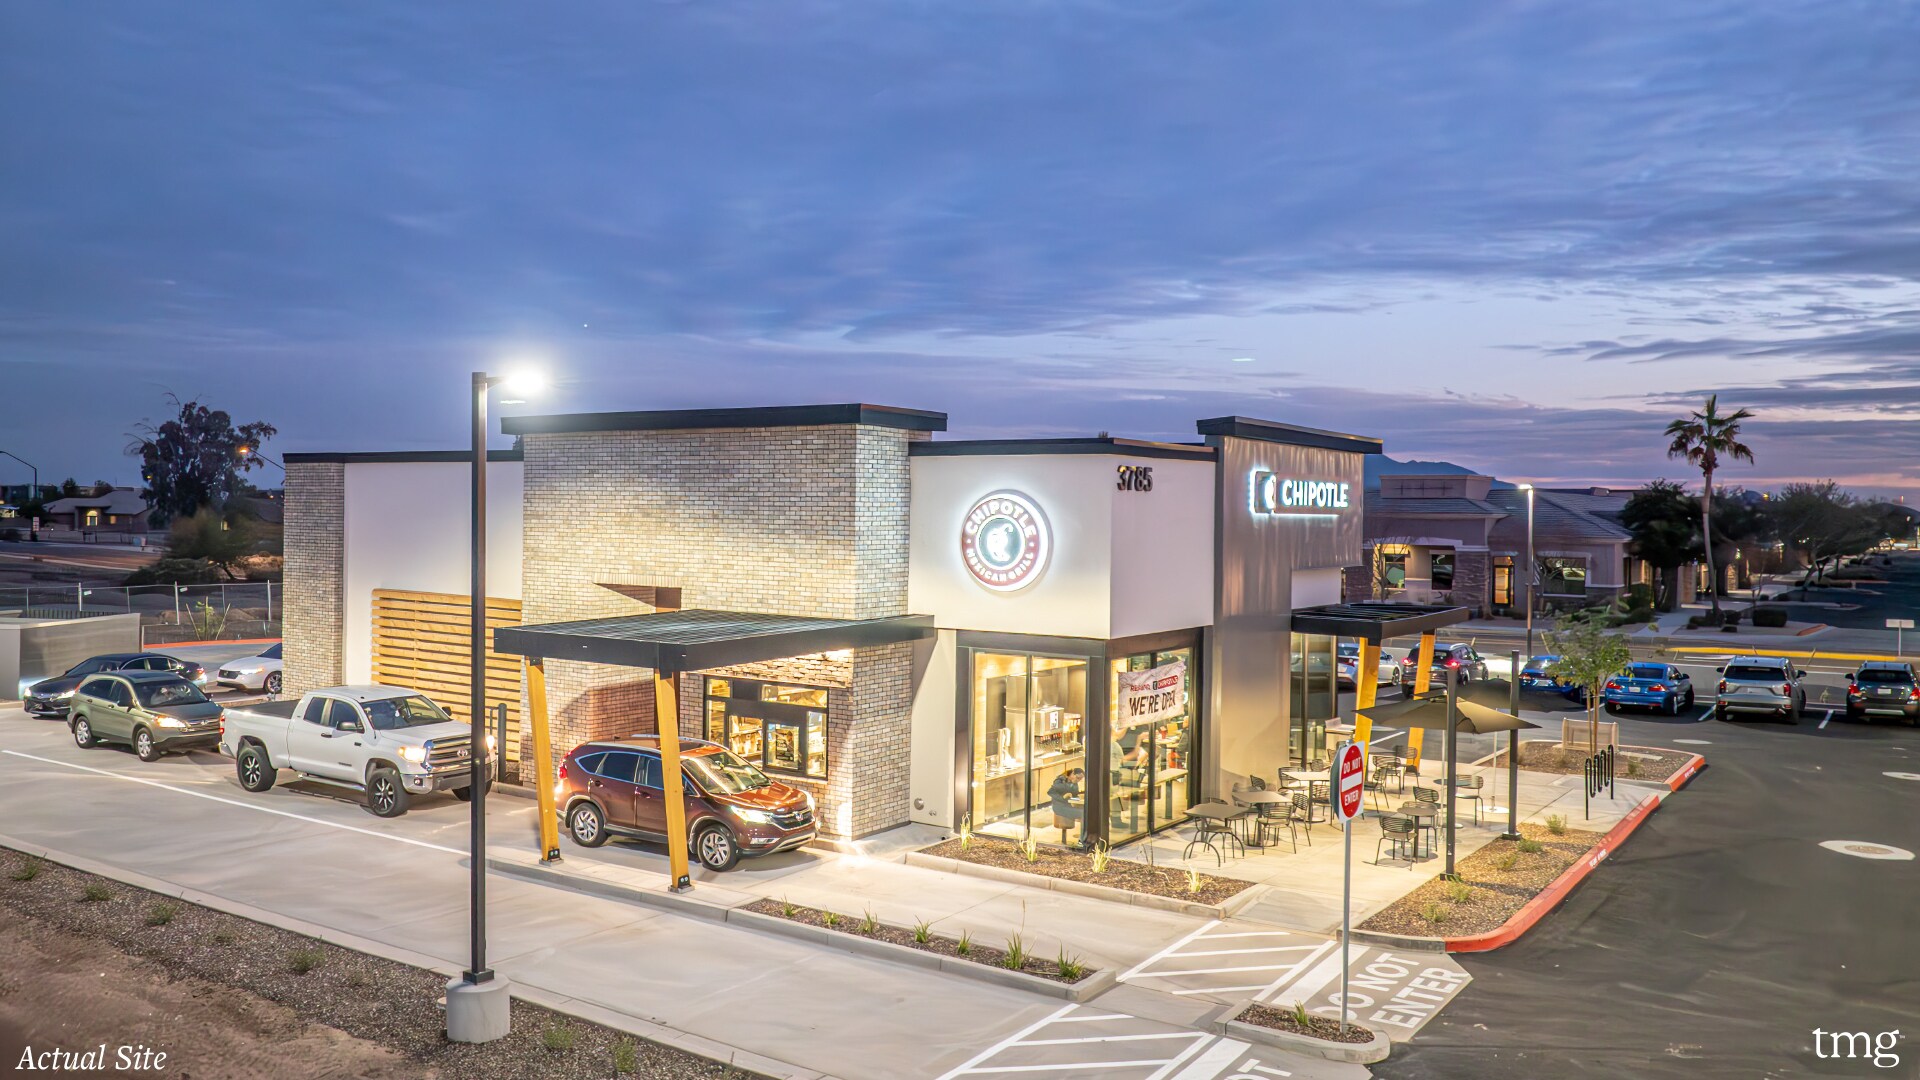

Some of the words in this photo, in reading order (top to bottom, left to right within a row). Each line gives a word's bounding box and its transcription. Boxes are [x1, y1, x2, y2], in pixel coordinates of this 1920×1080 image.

[1117, 465, 1153, 491] 3785
[1282, 479, 1349, 508] CHIPOTLE
[965, 501, 1037, 539] CHIPOTLE
[966, 548, 1007, 581] MEXICAN
[1007, 552, 1034, 580] GRILL
[1129, 694, 1160, 717] WE'RE
[1343, 761, 1351, 775] DO
[1351, 757, 1361, 771] NOT
[1344, 789, 1359, 806] ENTER
[1348, 952, 1420, 992] NOT
[1369, 967, 1472, 1029] ENTER
